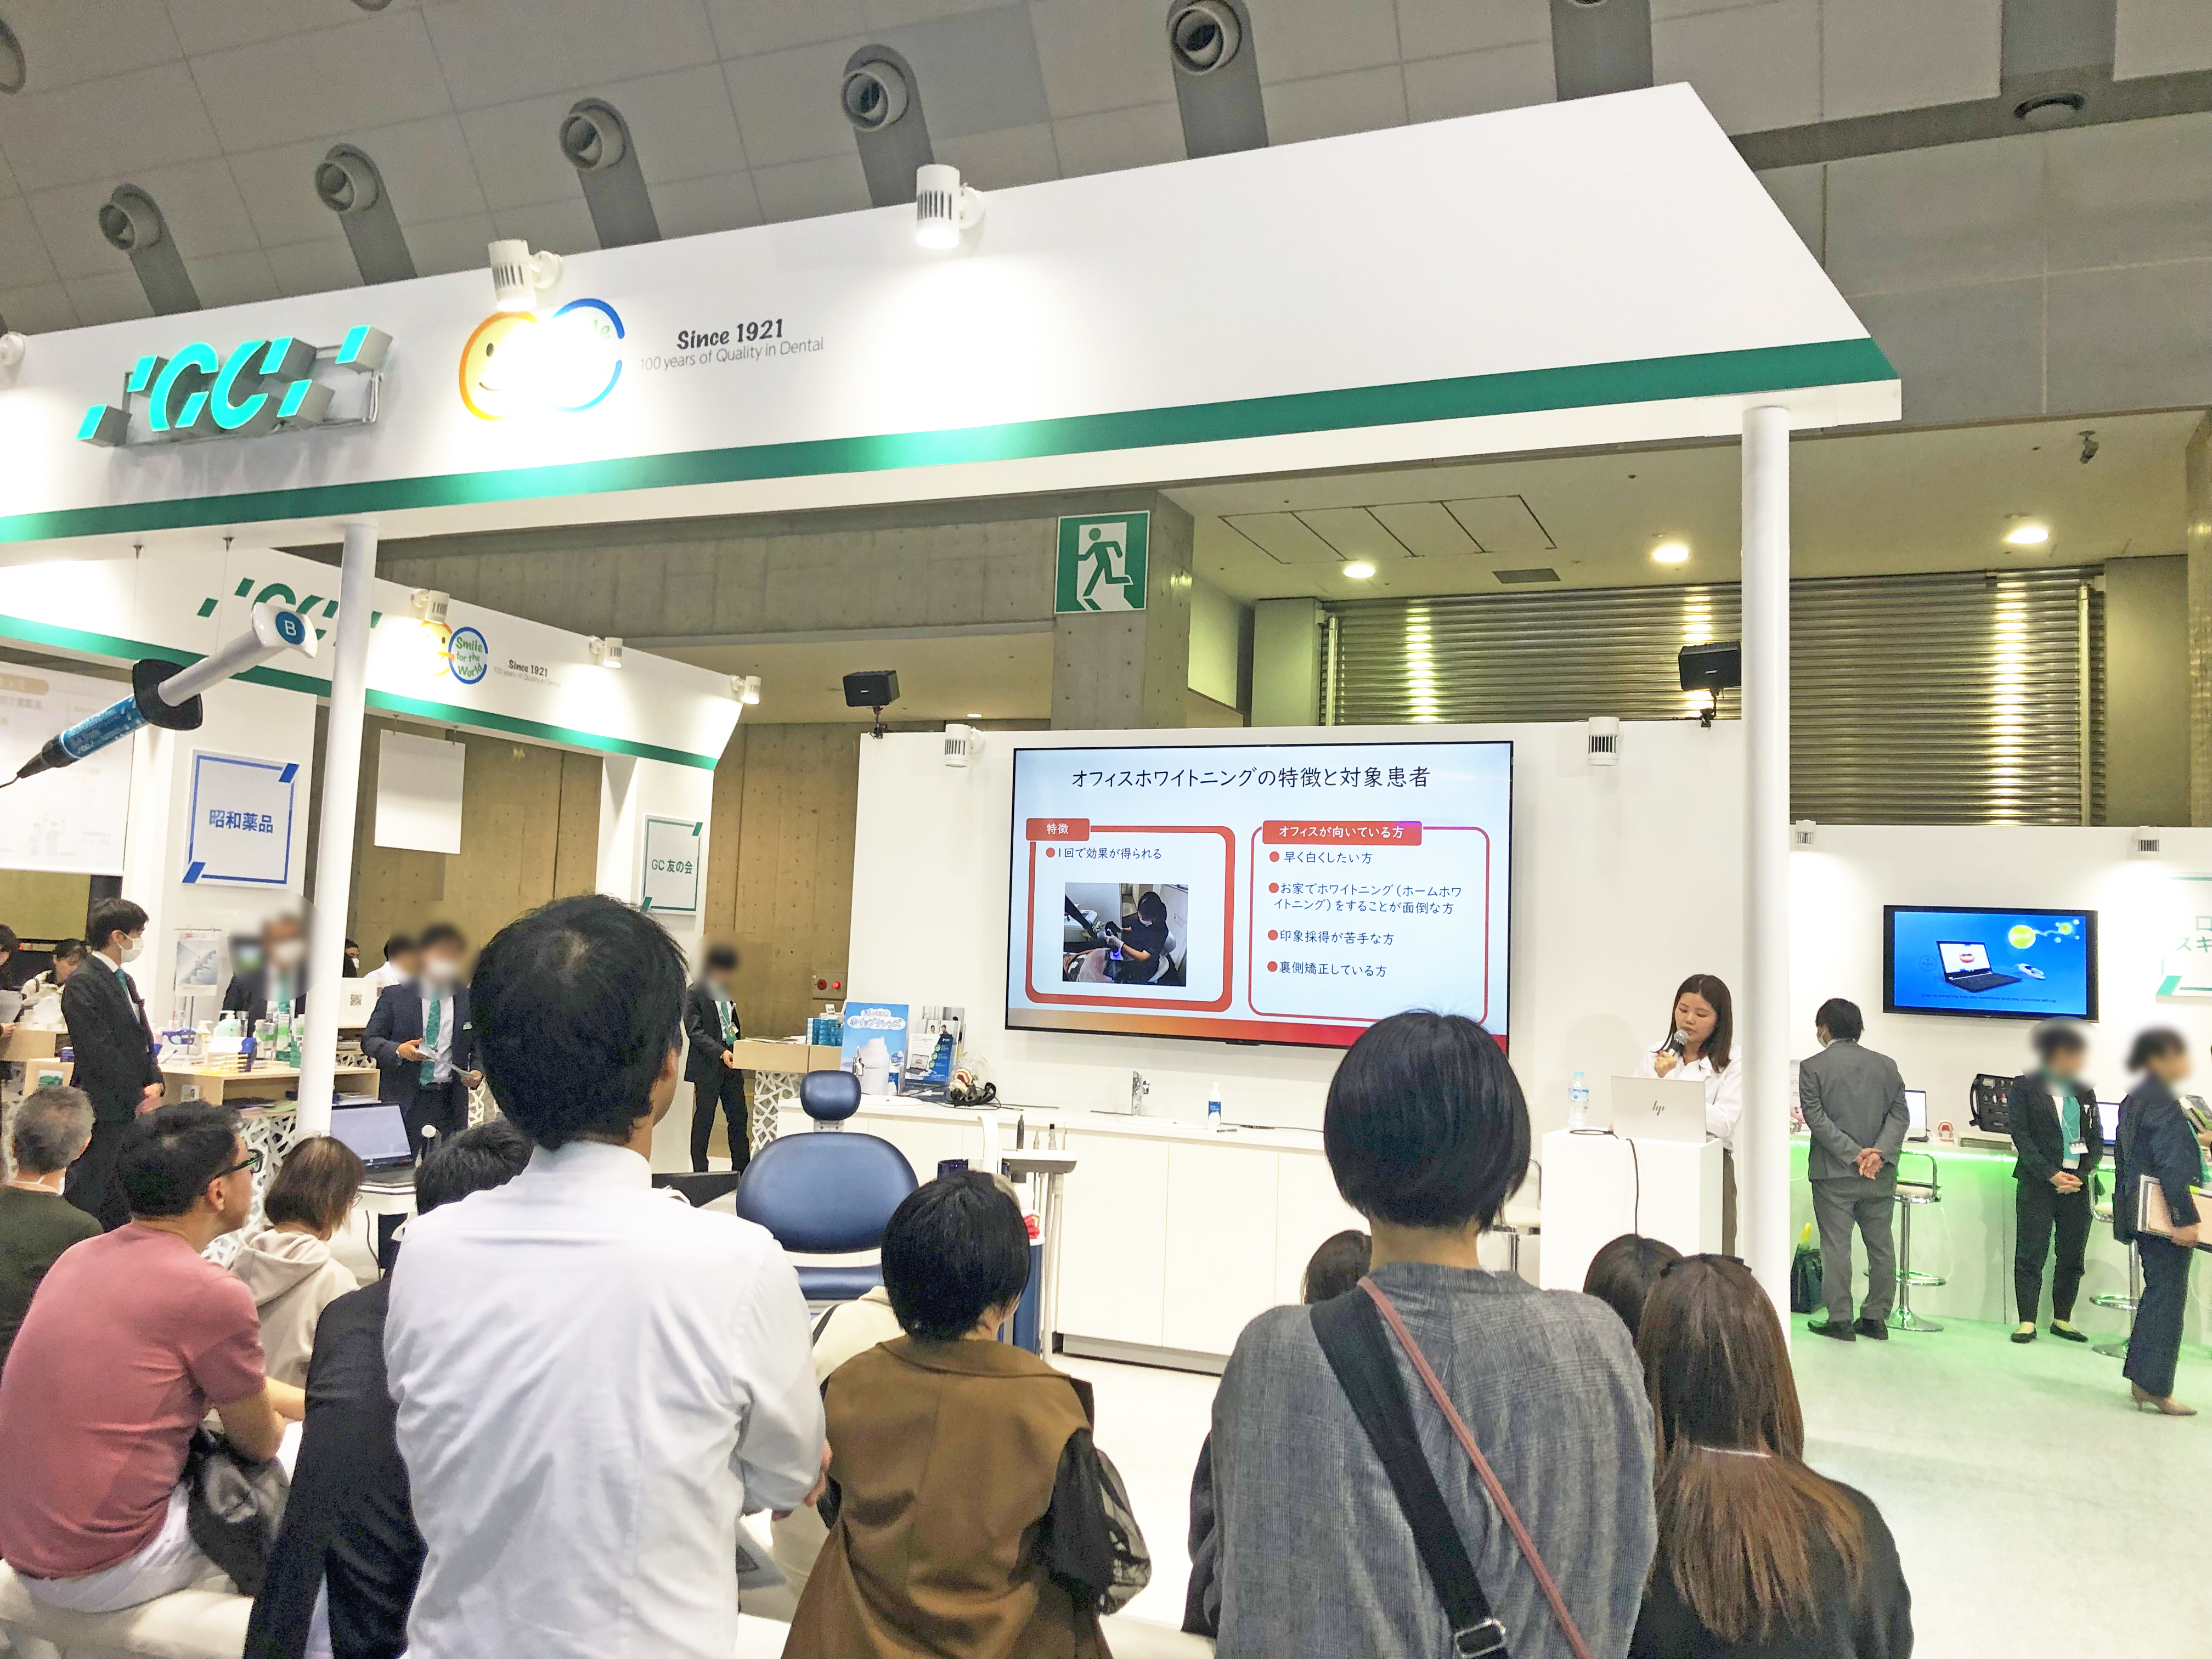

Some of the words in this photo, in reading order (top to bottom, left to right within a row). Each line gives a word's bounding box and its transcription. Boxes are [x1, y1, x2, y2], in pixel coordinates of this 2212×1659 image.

[676, 330, 729, 350] Since
[737, 319, 783, 342] 1921
[641, 356, 661, 371] 100
[664, 354, 696, 371] years
[699, 349, 712, 364] of
[716, 345, 762, 363] Quality
[765, 343, 776, 356] in
[780, 336, 824, 356] Dental
[284, 620, 297, 636] B
[456, 636, 483, 653] Smile
[456, 652, 465, 662] for
[469, 652, 480, 662] the
[458, 663, 483, 678] World
[509, 659, 528, 673] Since
[531, 665, 548, 677] 1921
[1072, 766, 1431, 788] オフィスホワイトニングの特徴と対象患者
[209, 809, 273, 833] 昭和薬品
[1046, 823, 1069, 834] 特徴
[1279, 826, 1404, 838] オフィスが向いている方
[1059, 848, 1161, 859] 1回で効果が得られる
[1284, 851, 1372, 864] 早く白くしたい方
[651, 859, 665, 871] GC
[667, 859, 693, 874] 友の会
[1280, 929, 1394, 945] 印象採得が苦手な方
[1279, 961, 1387, 977] 裏側矯正している方
[850, 1018, 902, 1028] ホイップクレンズ
